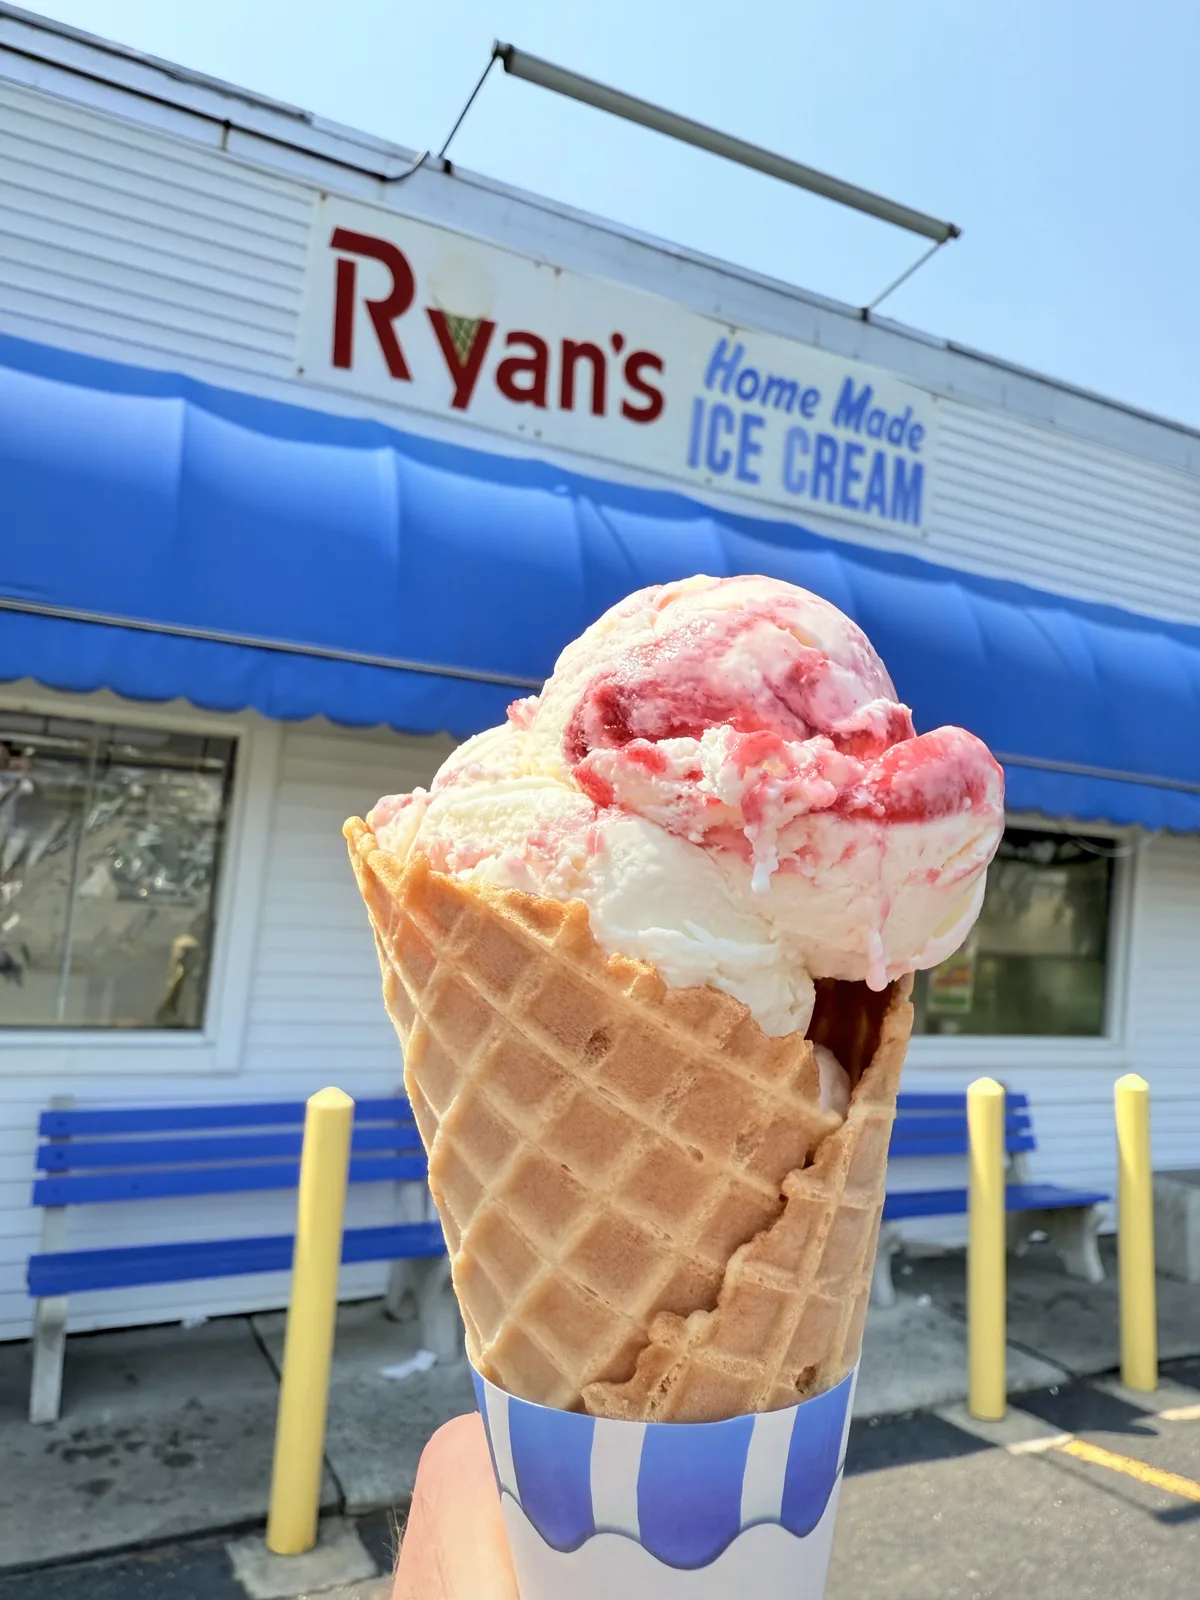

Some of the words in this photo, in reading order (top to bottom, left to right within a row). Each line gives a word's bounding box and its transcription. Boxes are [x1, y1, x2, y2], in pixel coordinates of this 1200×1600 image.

[330, 227, 665, 424] Ryan's
[704, 336, 820, 420] Home
[832, 377, 926, 453] Made
[687, 397, 766, 484] ICE
[783, 426, 925, 527] CREAM
